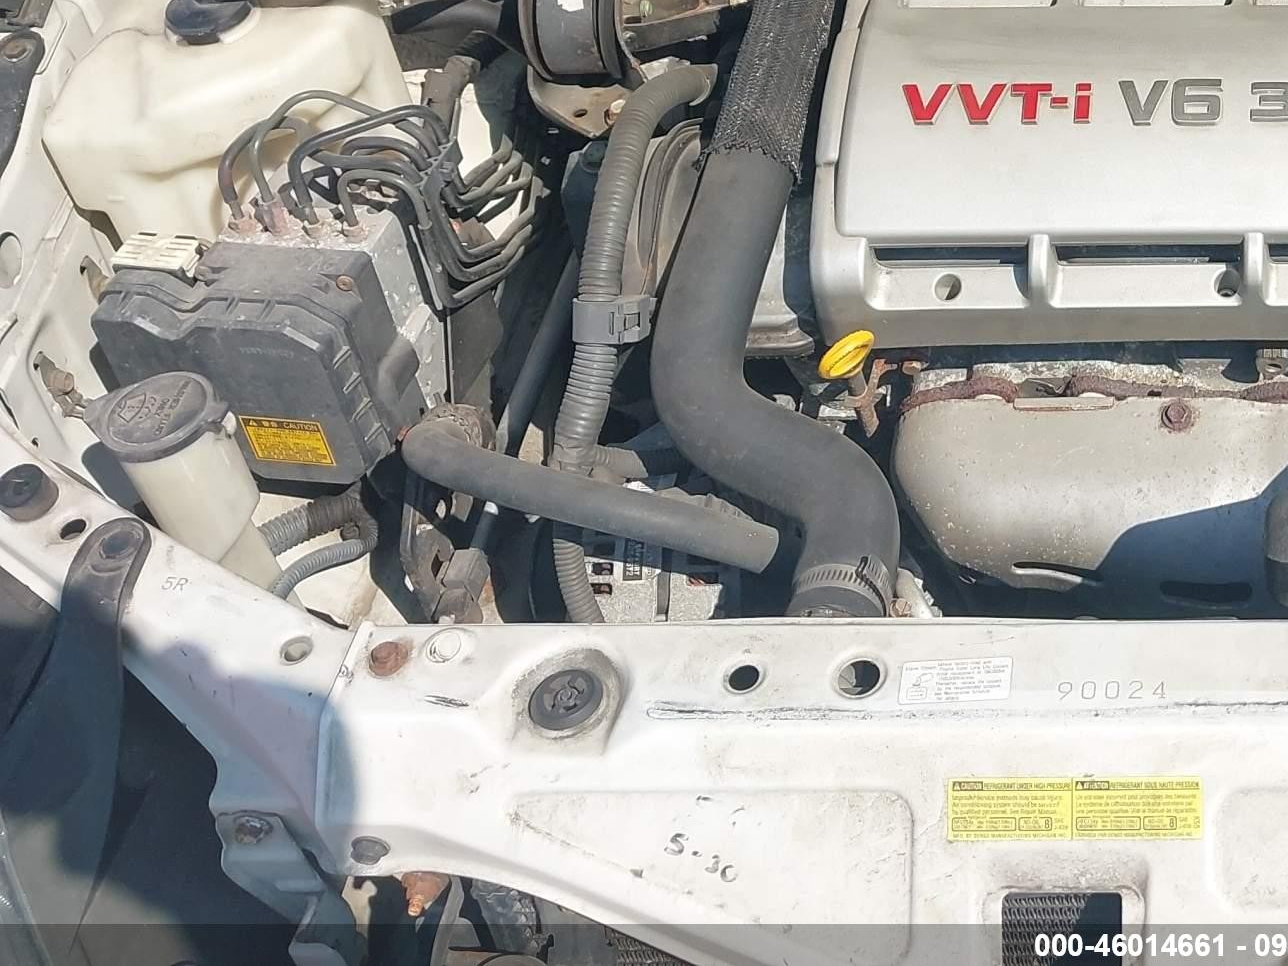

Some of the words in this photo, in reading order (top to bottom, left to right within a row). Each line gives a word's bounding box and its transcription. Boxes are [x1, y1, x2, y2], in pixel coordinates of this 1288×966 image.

[901, 82, 1093, 126] VVT-i
[1117, 79, 1225, 127] V6
[283, 421, 318, 431] CAUTION
[161, 576, 189, 591] 5R
[1057, 680, 1167, 700] 90024
